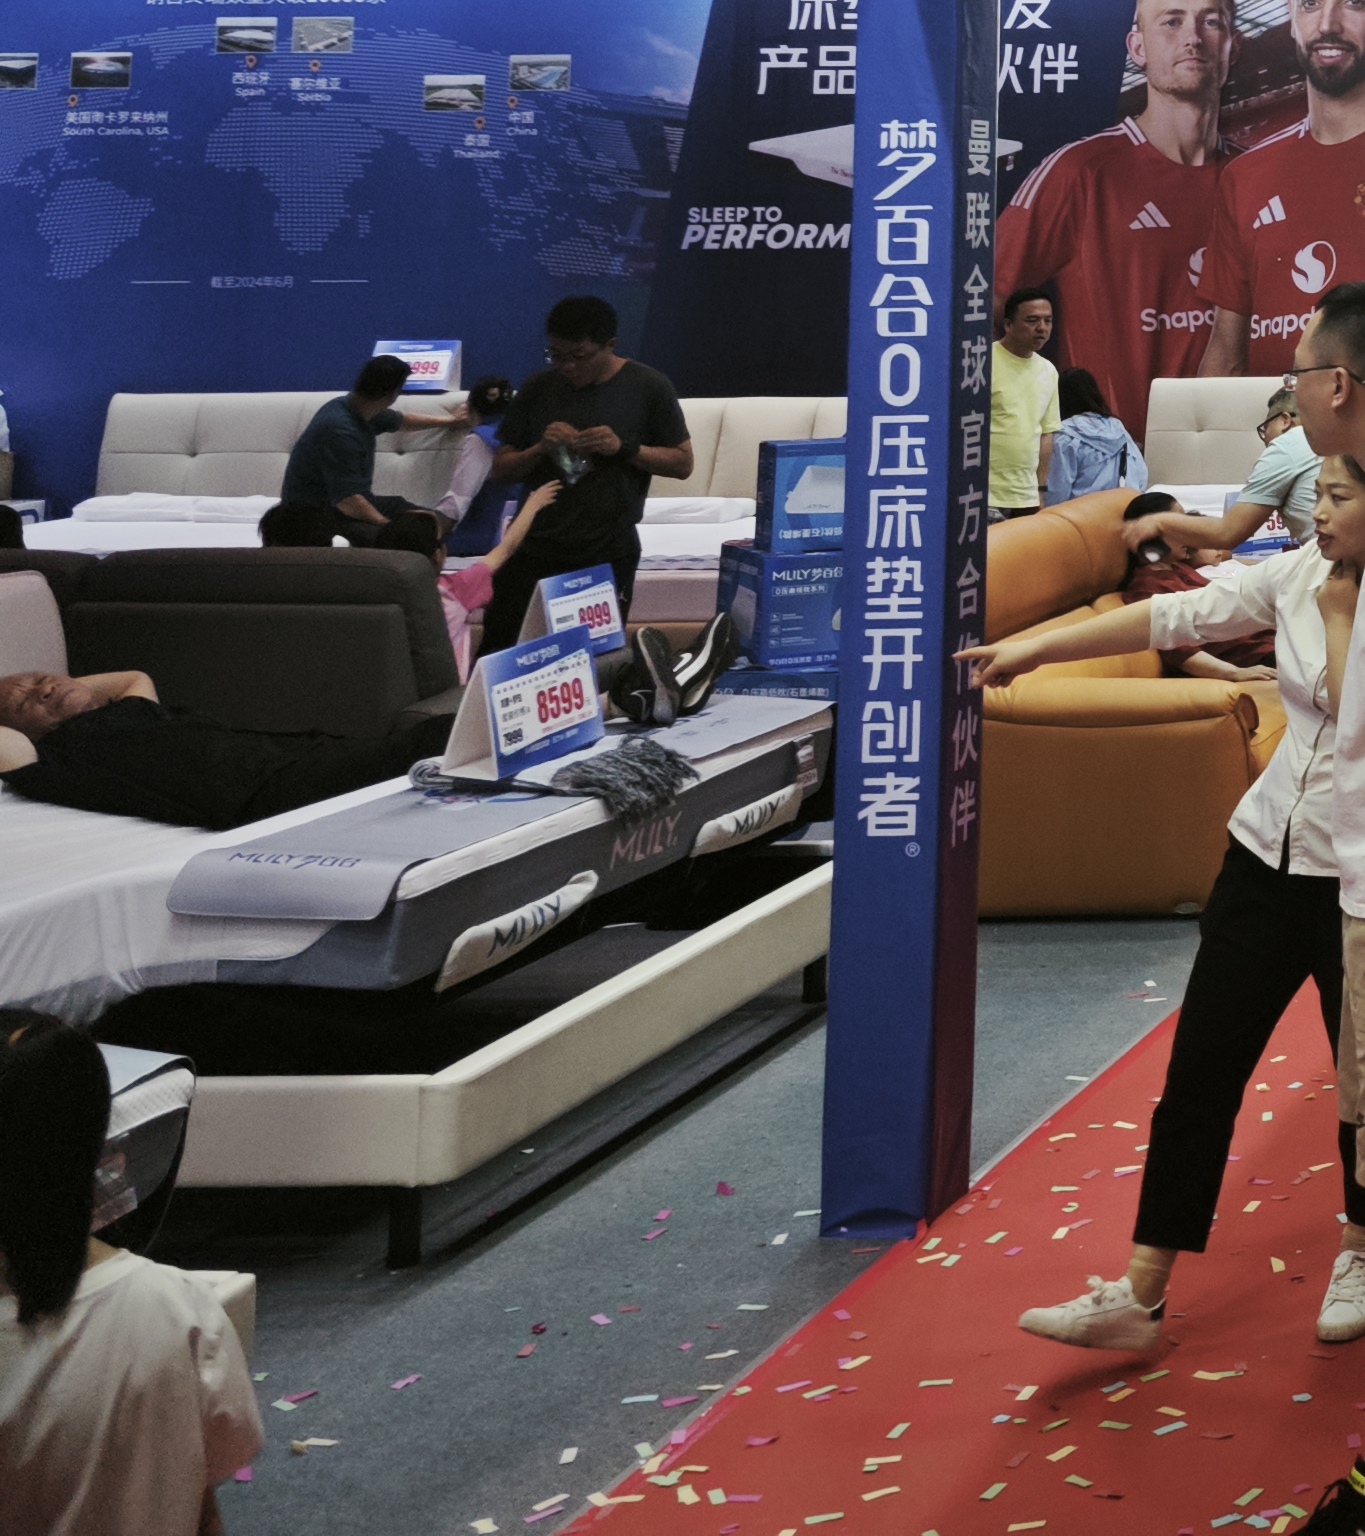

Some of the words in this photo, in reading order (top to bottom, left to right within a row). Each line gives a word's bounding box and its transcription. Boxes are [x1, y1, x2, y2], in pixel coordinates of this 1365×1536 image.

[235, 87, 266, 98] Spain
[62, 125, 95, 136] South
[146, 126, 169, 136] USA
[506, 126, 538, 136] China
[688, 206, 749, 224] SLEEP
[753, 206, 783, 223] TO
[680, 223, 852, 251] PERFORM
[855, 118, 938, 839] 梦百合0压床垫开创者
[948, 118, 993, 850] 曼联全球官方合作伙伴
[578, 600, 612, 629] 8999
[536, 677, 585, 724] 8599
[610, 810, 683, 871] MLILY
